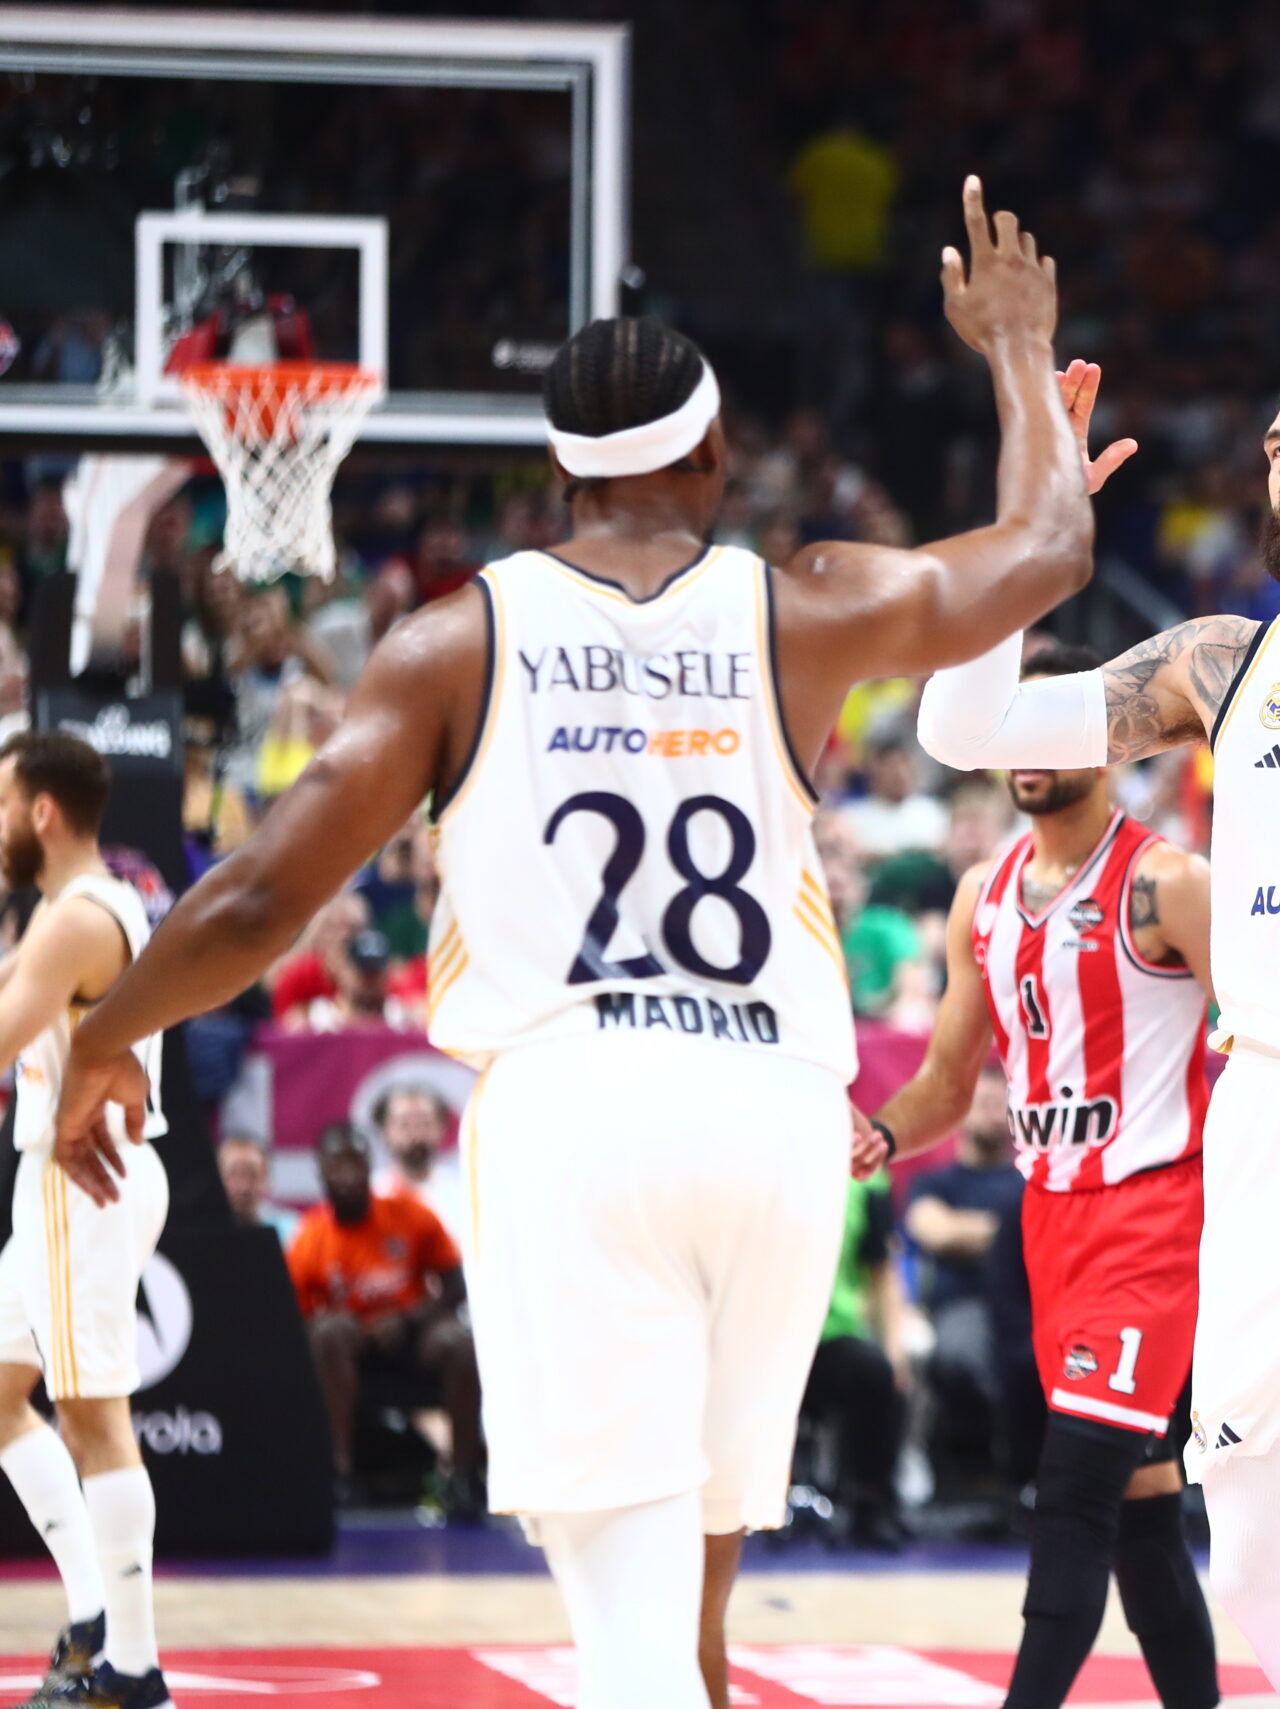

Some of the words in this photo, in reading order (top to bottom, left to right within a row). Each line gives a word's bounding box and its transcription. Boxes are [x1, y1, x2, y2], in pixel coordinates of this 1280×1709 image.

[518, 645, 752, 700] YABUSELE
[547, 726, 740, 757] AUTOHERO
[543, 791, 772, 985] 28
[595, 992, 779, 1044] MADRID
[1024, 978, 1045, 1034] 1
[1008, 1086, 1112, 1146] win
[1109, 1327, 1141, 1394] 1
